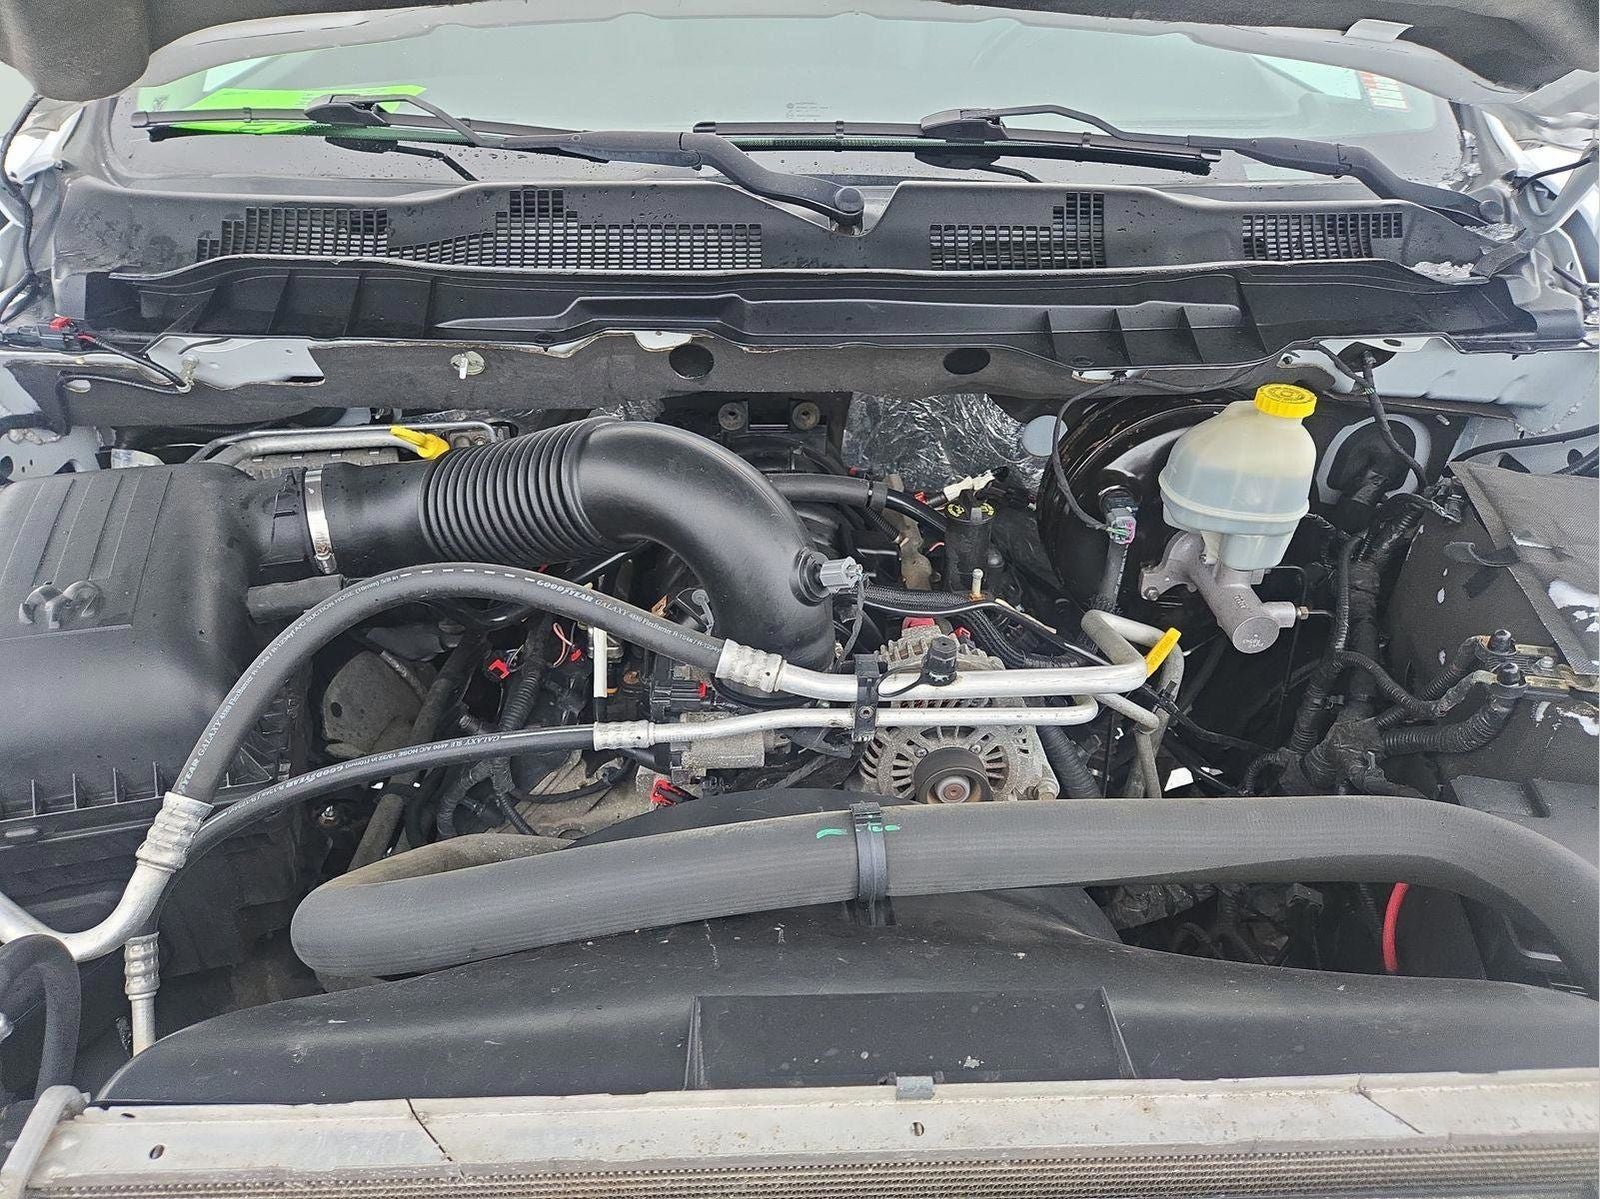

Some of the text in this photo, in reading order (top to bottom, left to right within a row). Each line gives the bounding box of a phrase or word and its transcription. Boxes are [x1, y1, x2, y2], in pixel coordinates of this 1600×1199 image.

[536, 580, 593, 602] GOODYEAR
[595, 600, 628, 616] GALAXY
[198, 719, 222, 756] GALAXY
[306, 601, 334, 623] SUCTION
[335, 592, 354, 605] HOSE
[465, 735, 500, 745] GALAXY
[398, 748, 419, 757] HOSE
[286, 765, 343, 788] GOODYEAR
